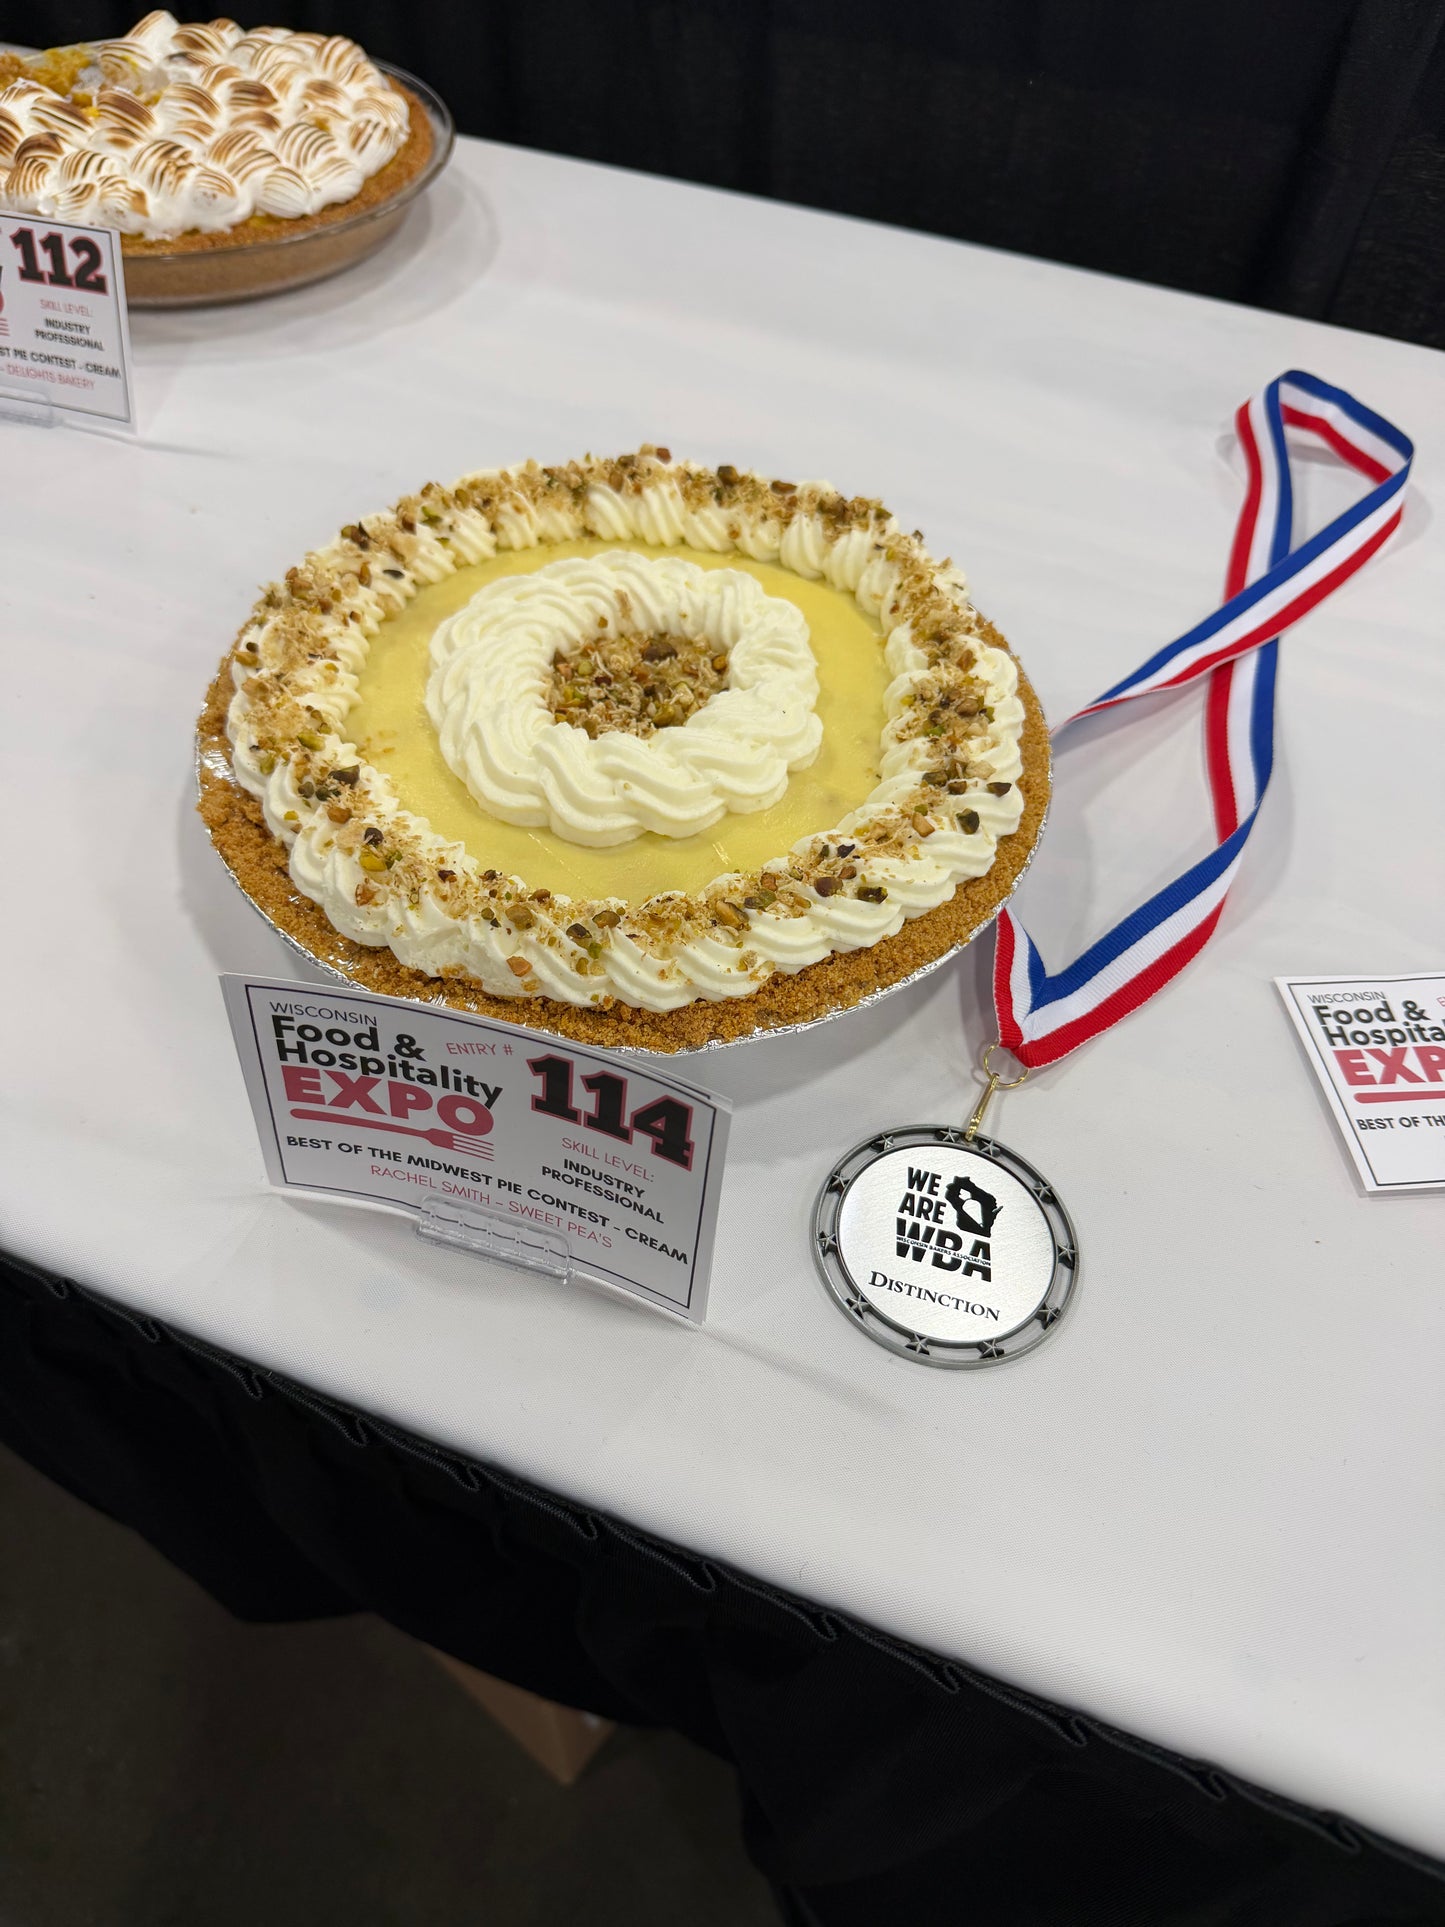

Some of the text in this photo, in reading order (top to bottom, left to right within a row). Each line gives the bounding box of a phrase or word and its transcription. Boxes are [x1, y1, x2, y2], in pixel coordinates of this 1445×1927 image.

[9, 227, 109, 296] 112
[40, 299, 62, 312] SKILL
[34, 328, 105, 351] PROFESSIONAL
[44, 317, 91, 335] INDUSTRY
[13, 349, 28, 361] PIE
[30, 351, 77, 370] CONTEST
[85, 362, 121, 379] CREAM
[58, 373, 95, 390] BAKERY
[269, 1001, 377, 1026] WISCONSIN
[1307, 991, 1386, 1004] WISCONSIN
[1313, 1000, 1396, 1026] Food
[1401, 1000, 1431, 1021] &
[272, 1014, 426, 1061] Food &
[447, 1042, 514, 1056] ENTRY #
[1322, 1019, 1445, 1047] Hospita
[276, 1038, 502, 1110] Hospitality
[281, 1065, 494, 1136] EXPO
[526, 1053, 695, 1172] 114
[1355, 1115, 1445, 1131] BEST OF TH
[561, 1137, 655, 1183] SKILL LEVEL:
[563, 1158, 646, 1199] INDUSTRY
[908, 1166, 942, 1197] WE
[286, 1136, 332, 1151] BEST
[337, 1142, 363, 1155] OF
[367, 1147, 402, 1163] THE
[407, 1154, 493, 1186] MIDWEST
[497, 1178, 523, 1195] PIE
[527, 1188, 610, 1228] CONTEST
[624, 1227, 689, 1265] CREAM
[370, 1165, 437, 1189] RACHEL
[441, 1180, 490, 1205] SMITH
[509, 1200, 562, 1228] SWEET
[567, 1222, 613, 1249] PEA'S
[542, 1166, 665, 1224] PROFESSIONAL
[897, 1191, 947, 1225] ARE
[896, 1217, 992, 1283] WBA
[896, 1235, 991, 1267] WISCONSIN BAKERS ASSOCIATION
